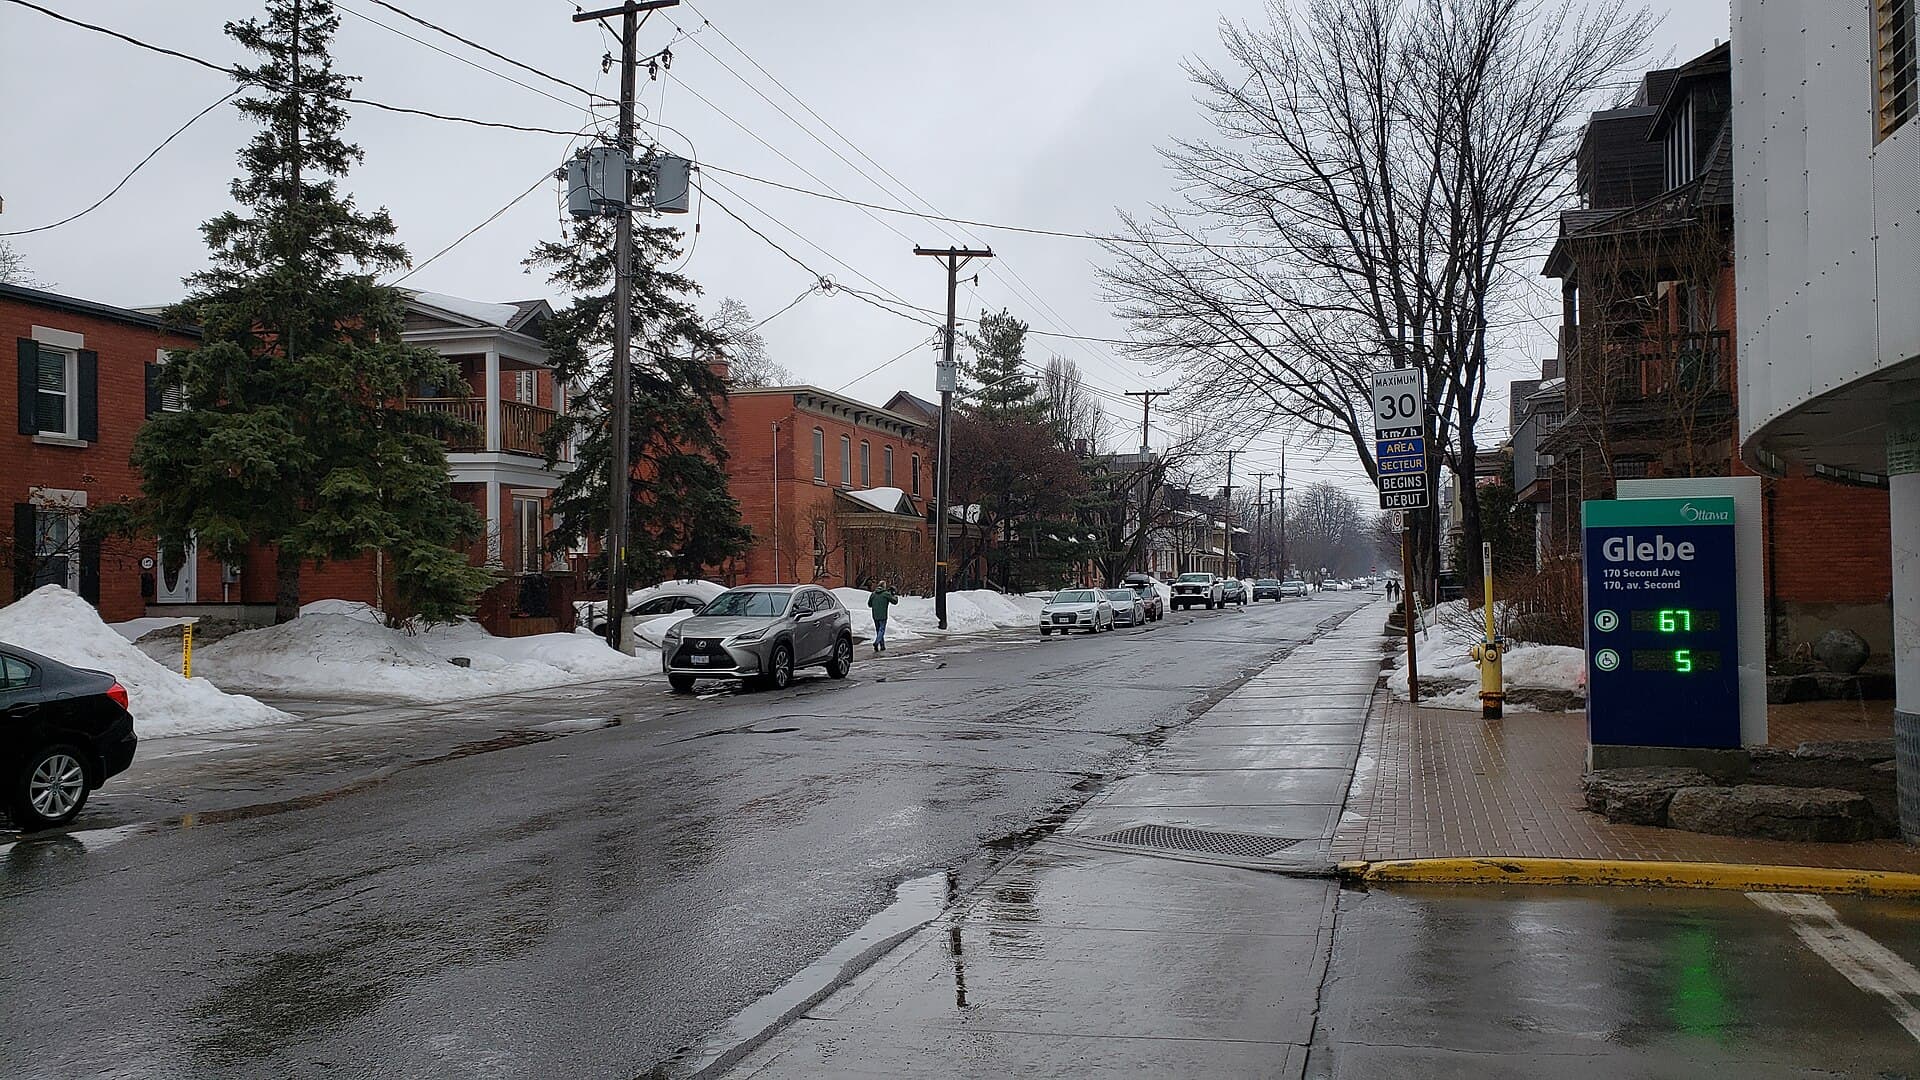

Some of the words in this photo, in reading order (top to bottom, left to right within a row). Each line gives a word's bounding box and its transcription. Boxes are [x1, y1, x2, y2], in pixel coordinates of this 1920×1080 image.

[1376, 375, 1416, 388] MAXIMUM
[1379, 393, 1416, 420] 30
[1386, 442, 1415, 454] AREA
[1381, 459, 1422, 471] SECTEUR
[1383, 476, 1422, 490] BEGINS
[1386, 492, 1421, 507] DÉBUT
[1680, 503, 1729, 521] Ottawa
[1602, 535, 1695, 562] Glebe
[1603, 569, 1621, 578] 170
[1623, 568, 1659, 577] Second
[1661, 569, 1681, 577] Ave
[1603, 581, 1625, 591] 170,
[1626, 582, 1641, 590] av.
[1644, 580, 1681, 589] Second
[1659, 610, 1691, 632] 67
[1675, 650, 1692, 672] 5
